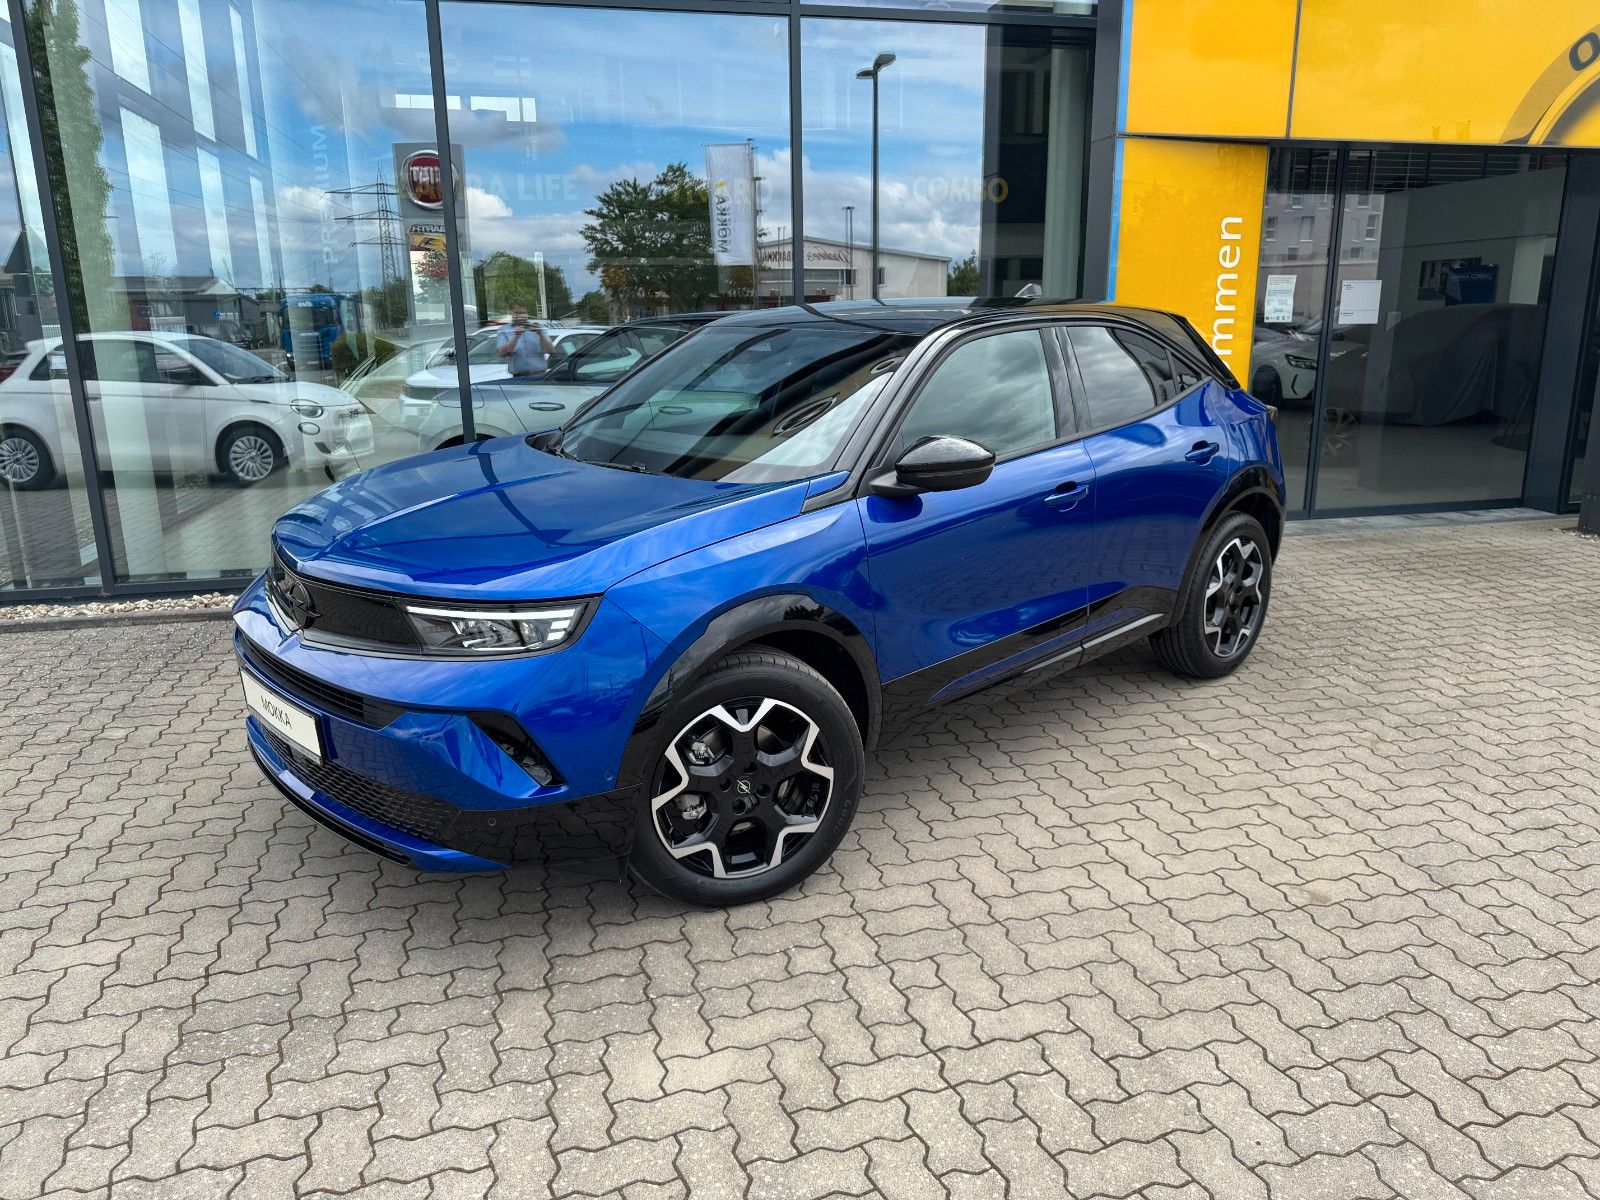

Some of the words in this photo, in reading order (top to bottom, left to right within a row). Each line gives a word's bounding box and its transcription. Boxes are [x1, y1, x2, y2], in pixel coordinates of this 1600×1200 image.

[517, 173, 580, 201] LIFE
[1211, 216, 1243, 370] mmen
[260, 695, 293, 730] MOKKA
